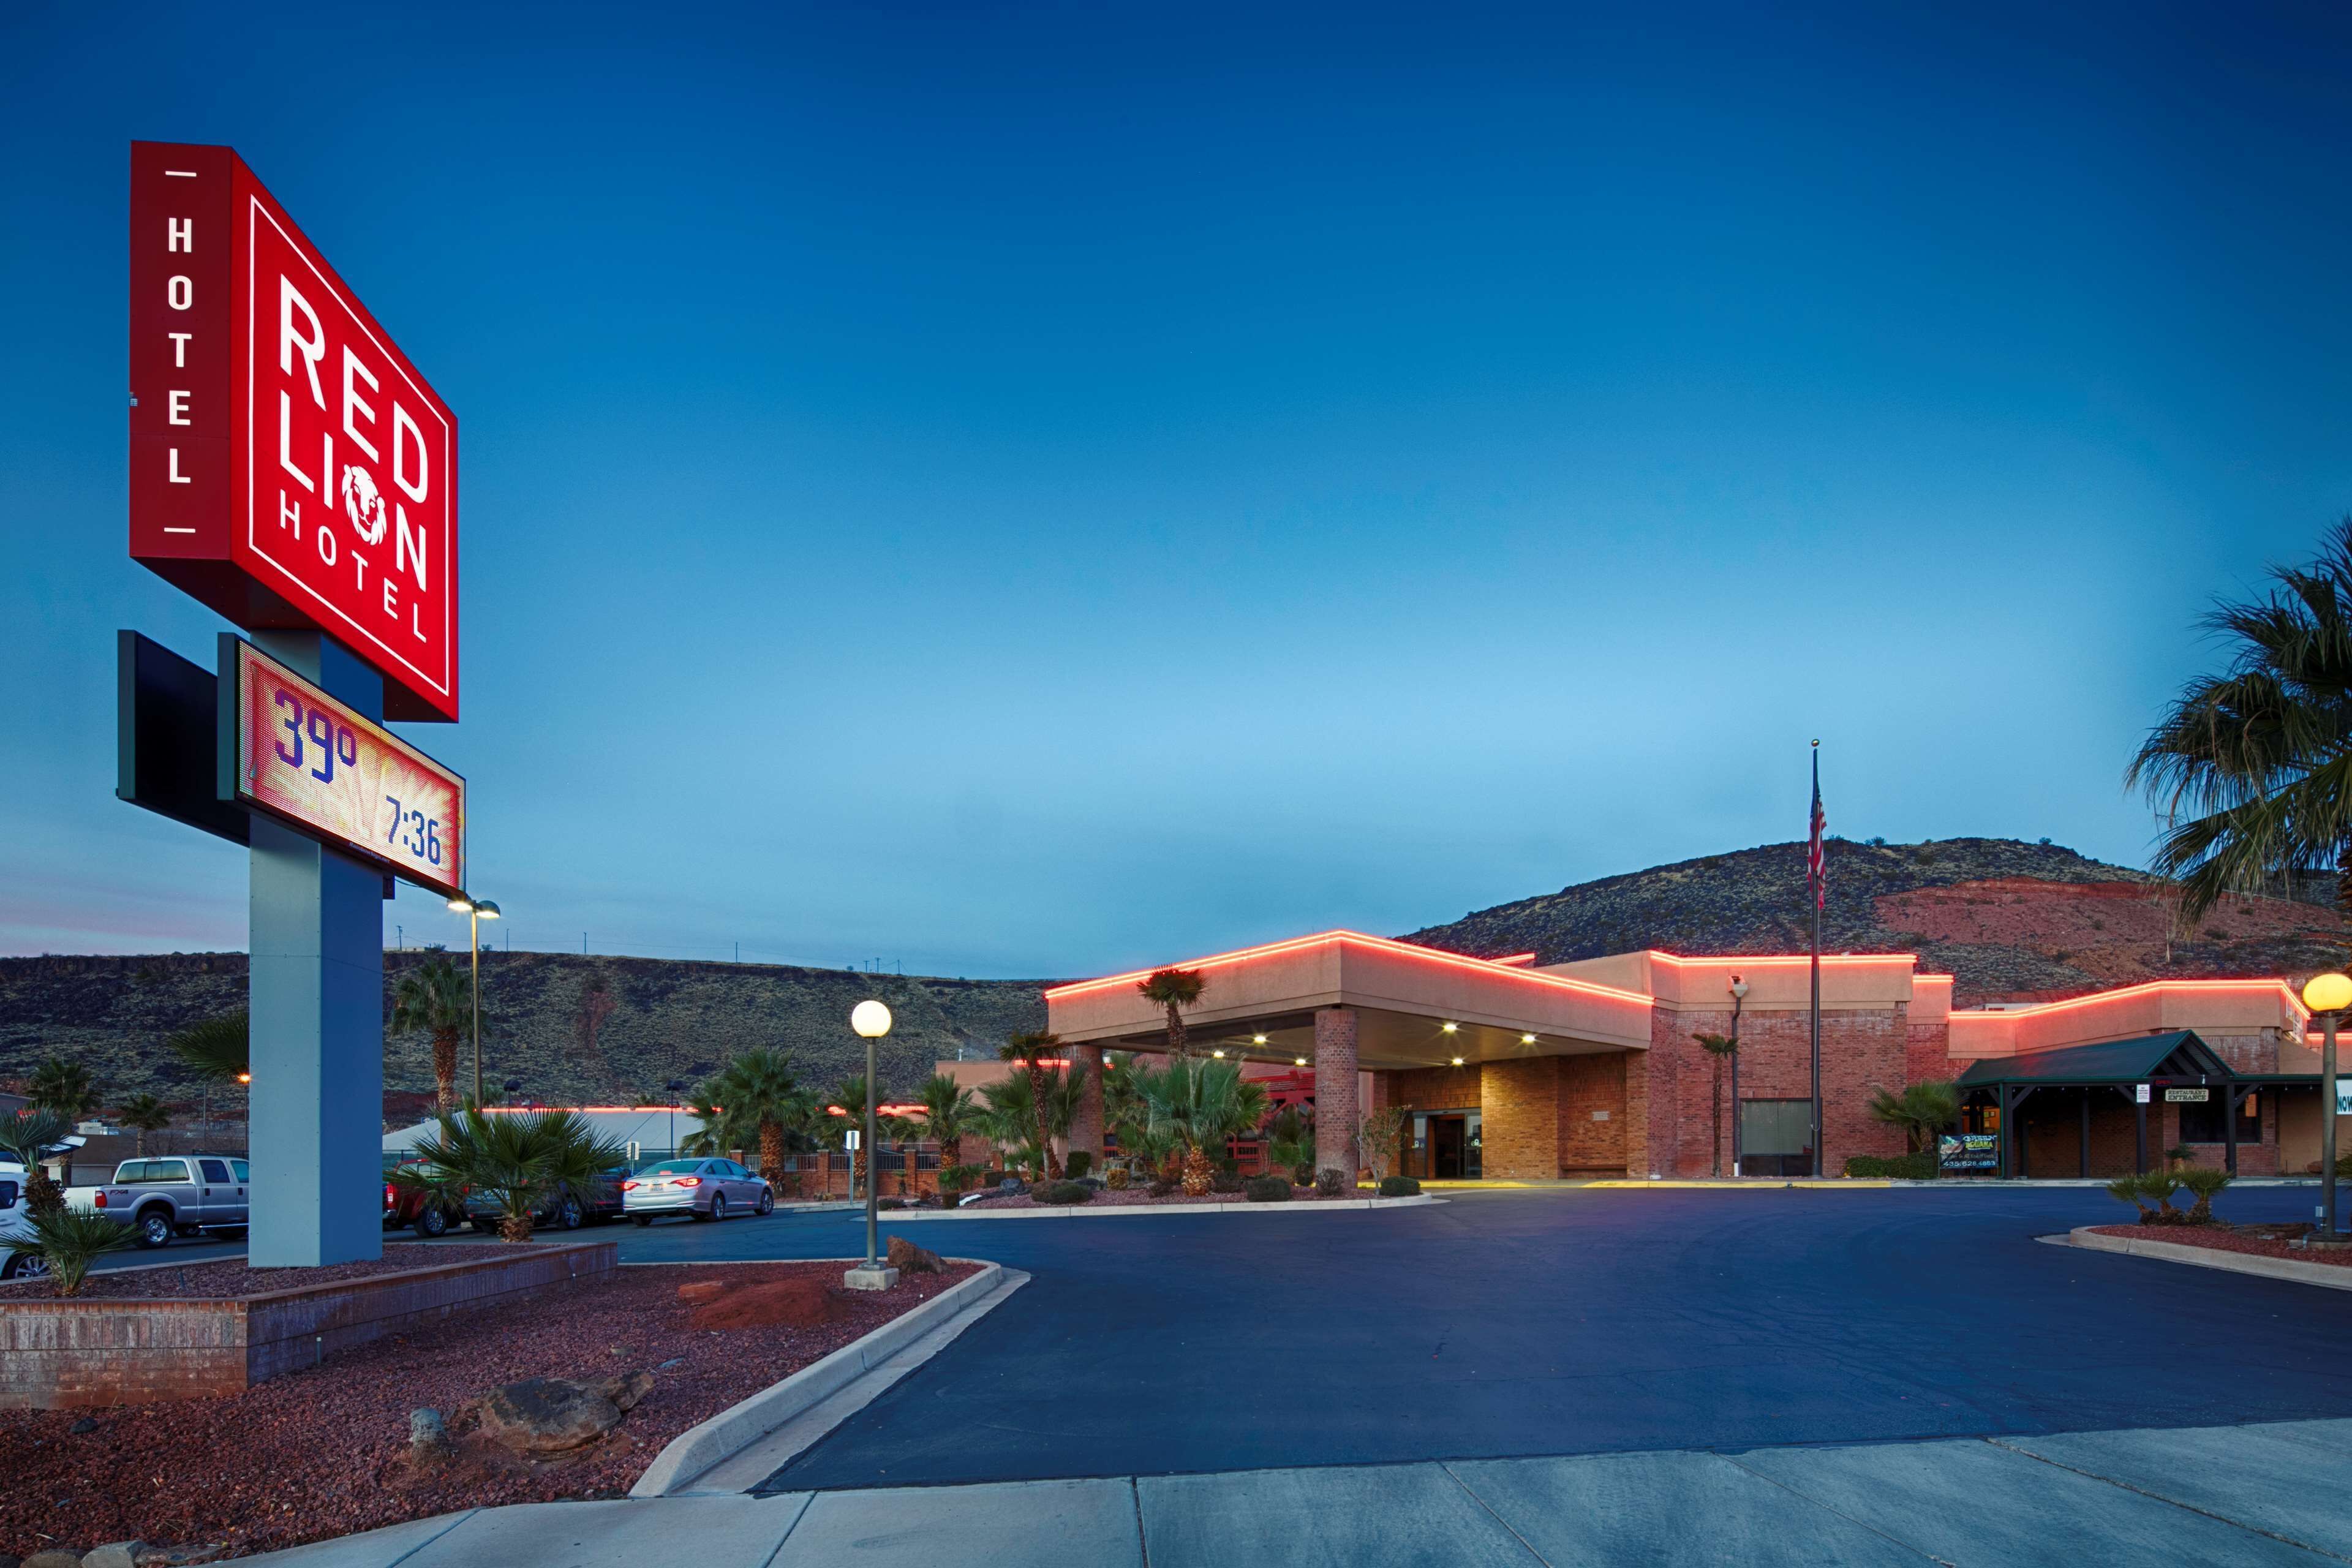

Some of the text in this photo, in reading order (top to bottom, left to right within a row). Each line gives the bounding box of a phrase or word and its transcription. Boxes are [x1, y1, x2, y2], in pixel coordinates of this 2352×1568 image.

[168, 217, 192, 483] HOTEL
[281, 273, 428, 504] RED
[281, 488, 427, 644] HOTEL
[386, 795, 441, 865] 7:36
[2337, 1096, 2352, 1112] NOW
